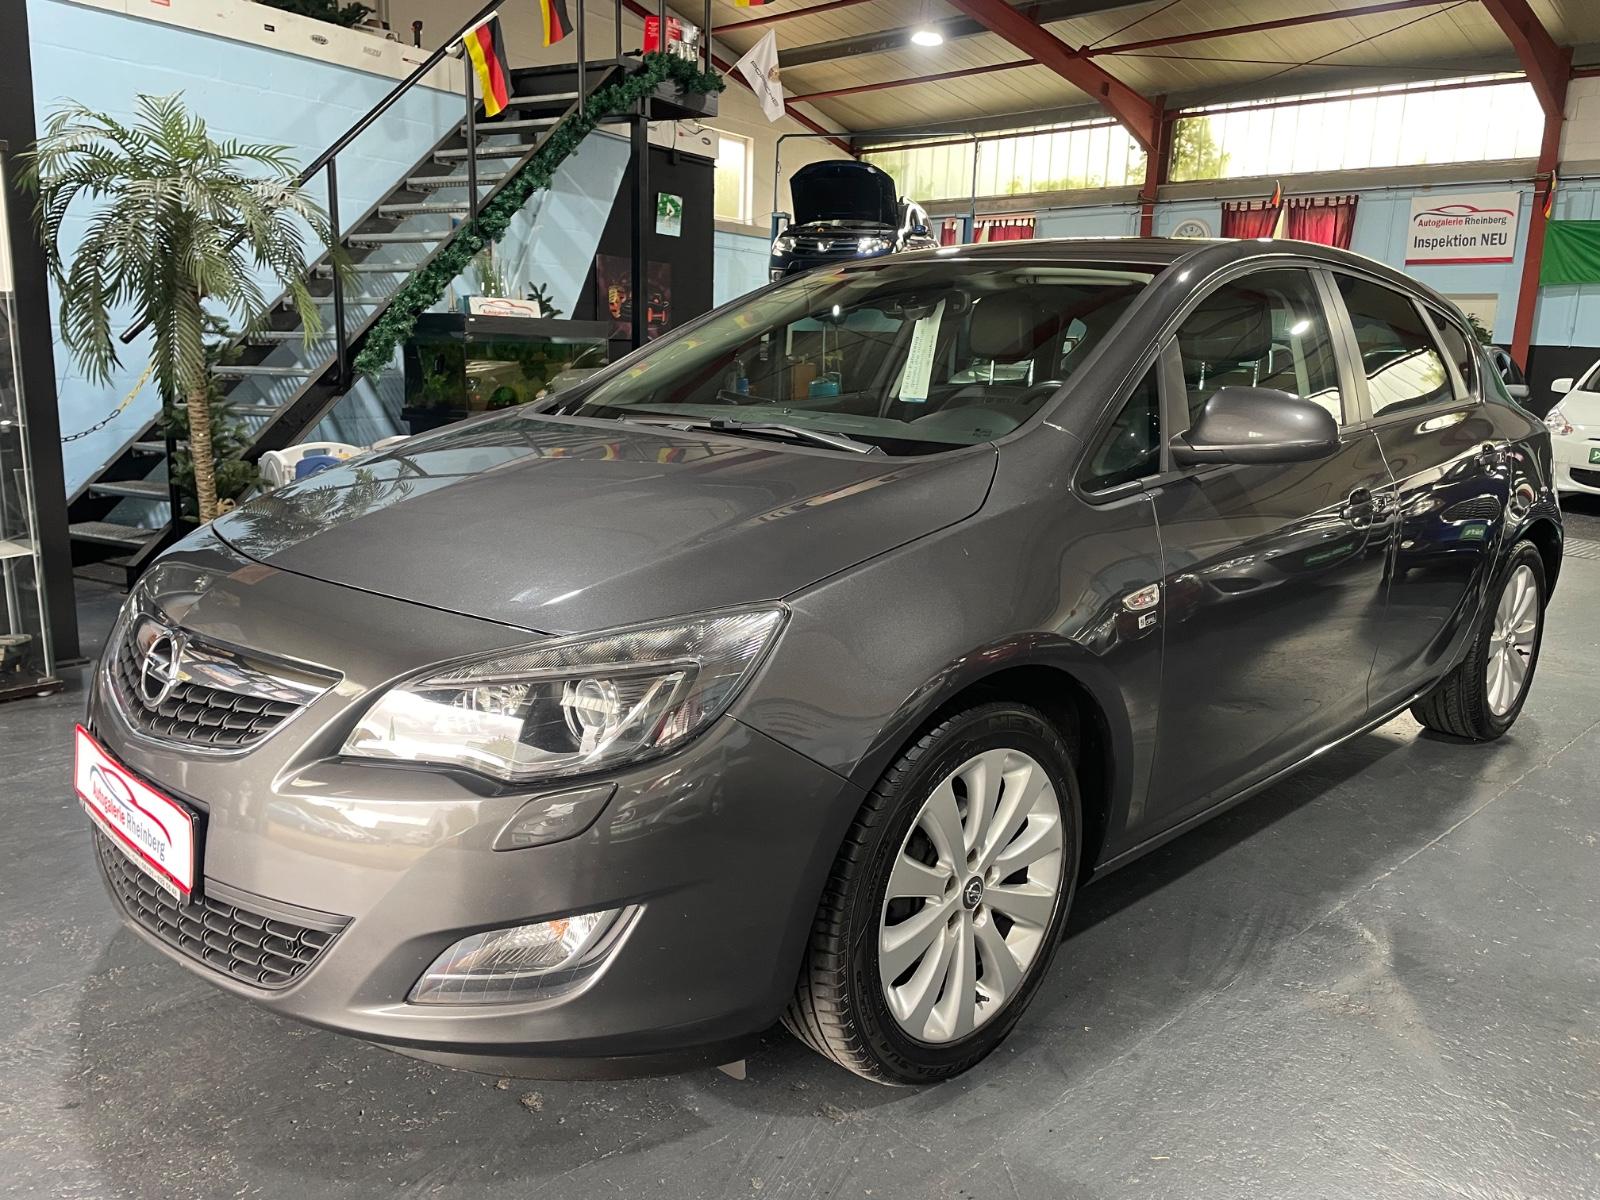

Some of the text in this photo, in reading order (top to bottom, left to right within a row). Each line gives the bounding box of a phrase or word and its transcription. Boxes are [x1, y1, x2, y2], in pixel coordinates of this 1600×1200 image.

[751, 61, 779, 107] PORCHE
[1417, 216, 1507, 228] Autogalerie Rheinberg
[1414, 233, 1507, 250] Inspektion NEU
[92, 780, 126, 826] Autogalerie
[126, 812, 166, 862] Rheinberg
